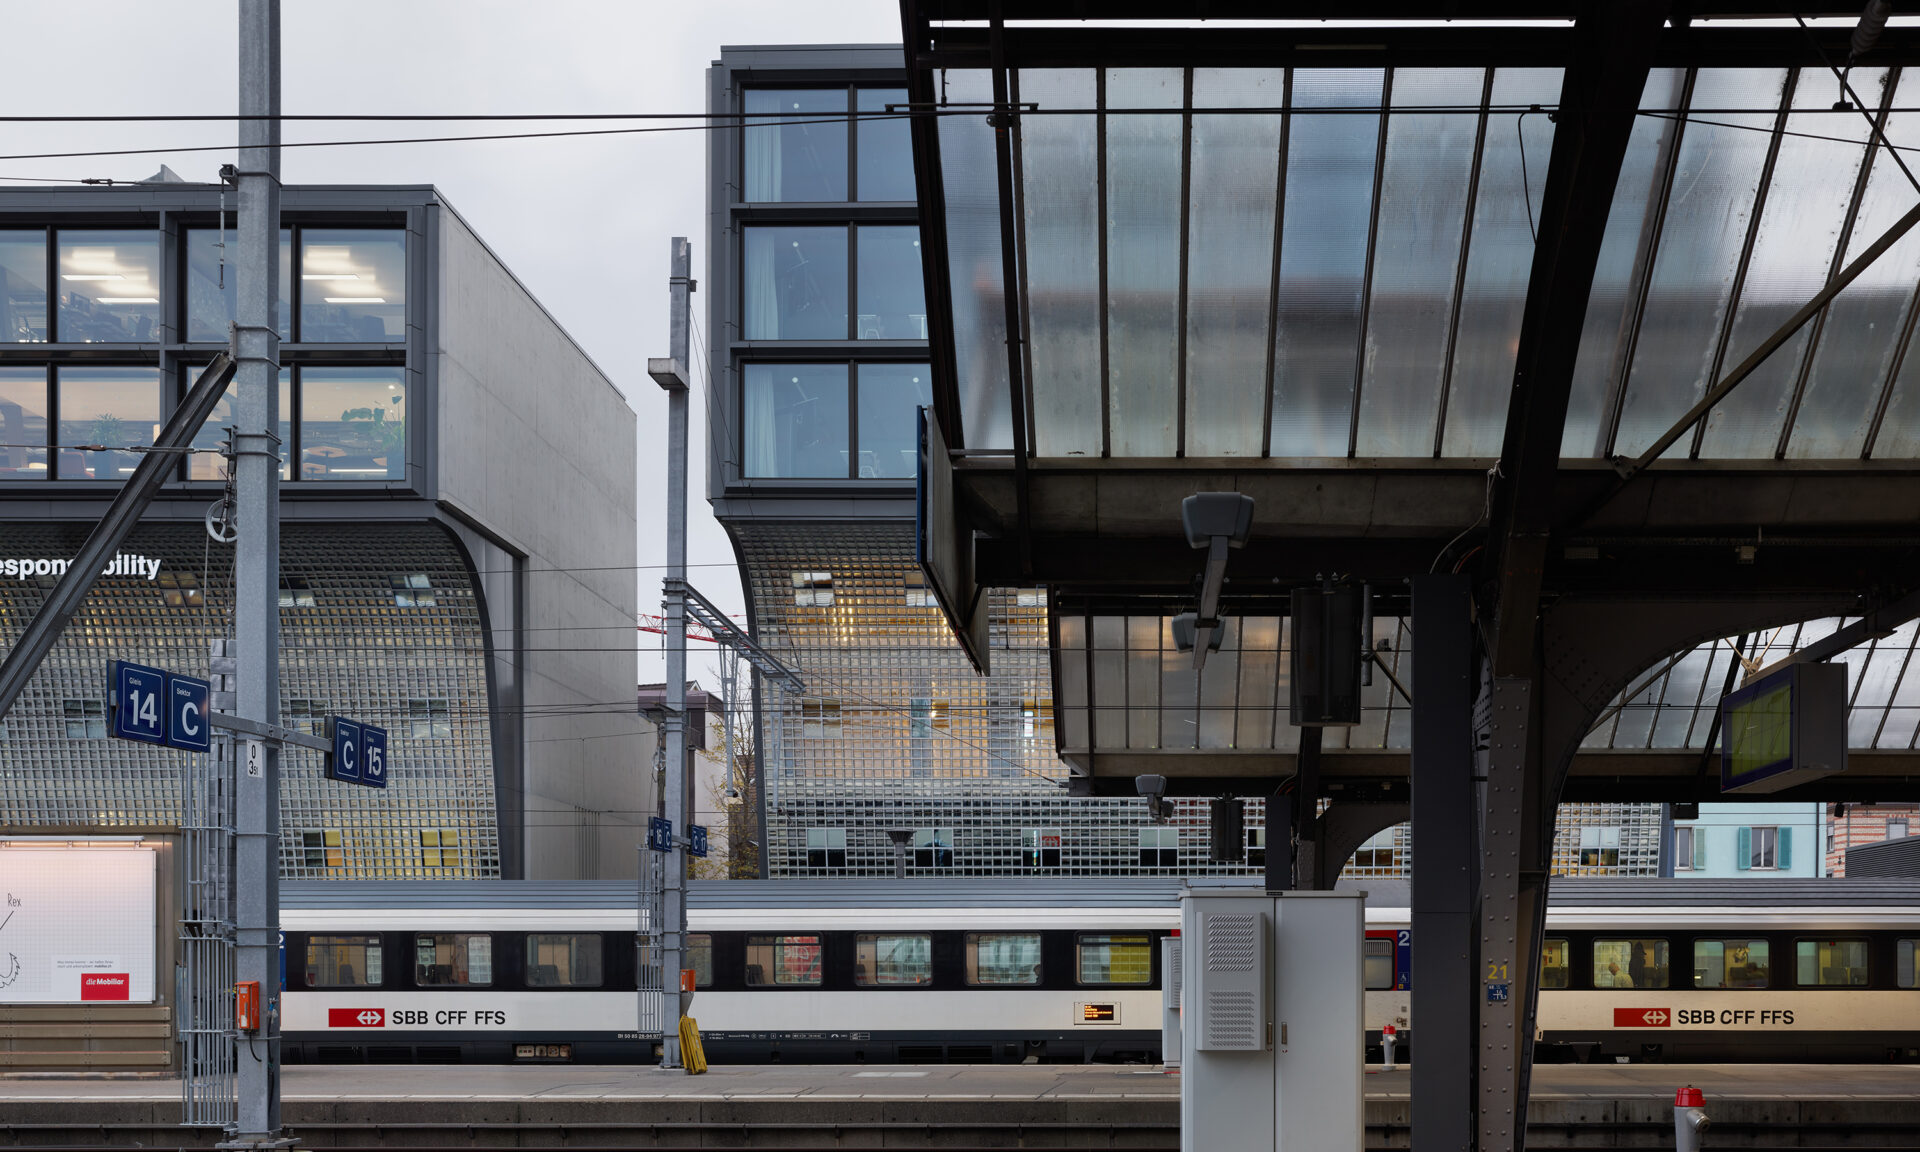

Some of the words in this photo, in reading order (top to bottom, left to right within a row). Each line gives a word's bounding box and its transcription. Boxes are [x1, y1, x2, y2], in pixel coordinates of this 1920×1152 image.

[130, 689, 158, 729] 14
[182, 701, 199, 736] C
[251, 744, 256, 759] 0
[343, 740, 354, 770] C
[367, 745, 382, 776] 15
[7, 892, 22, 908] Rex
[1398, 931, 1410, 947] 2
[1487, 964, 1508, 980] 21
[392, 1010, 429, 1025] SBB
[435, 1010, 468, 1025] CFF
[474, 1010, 506, 1025] FFS
[1677, 1009, 1716, 1025] SBB
[1720, 1009, 1755, 1025] CFF
[1760, 1009, 1795, 1025] FFS
